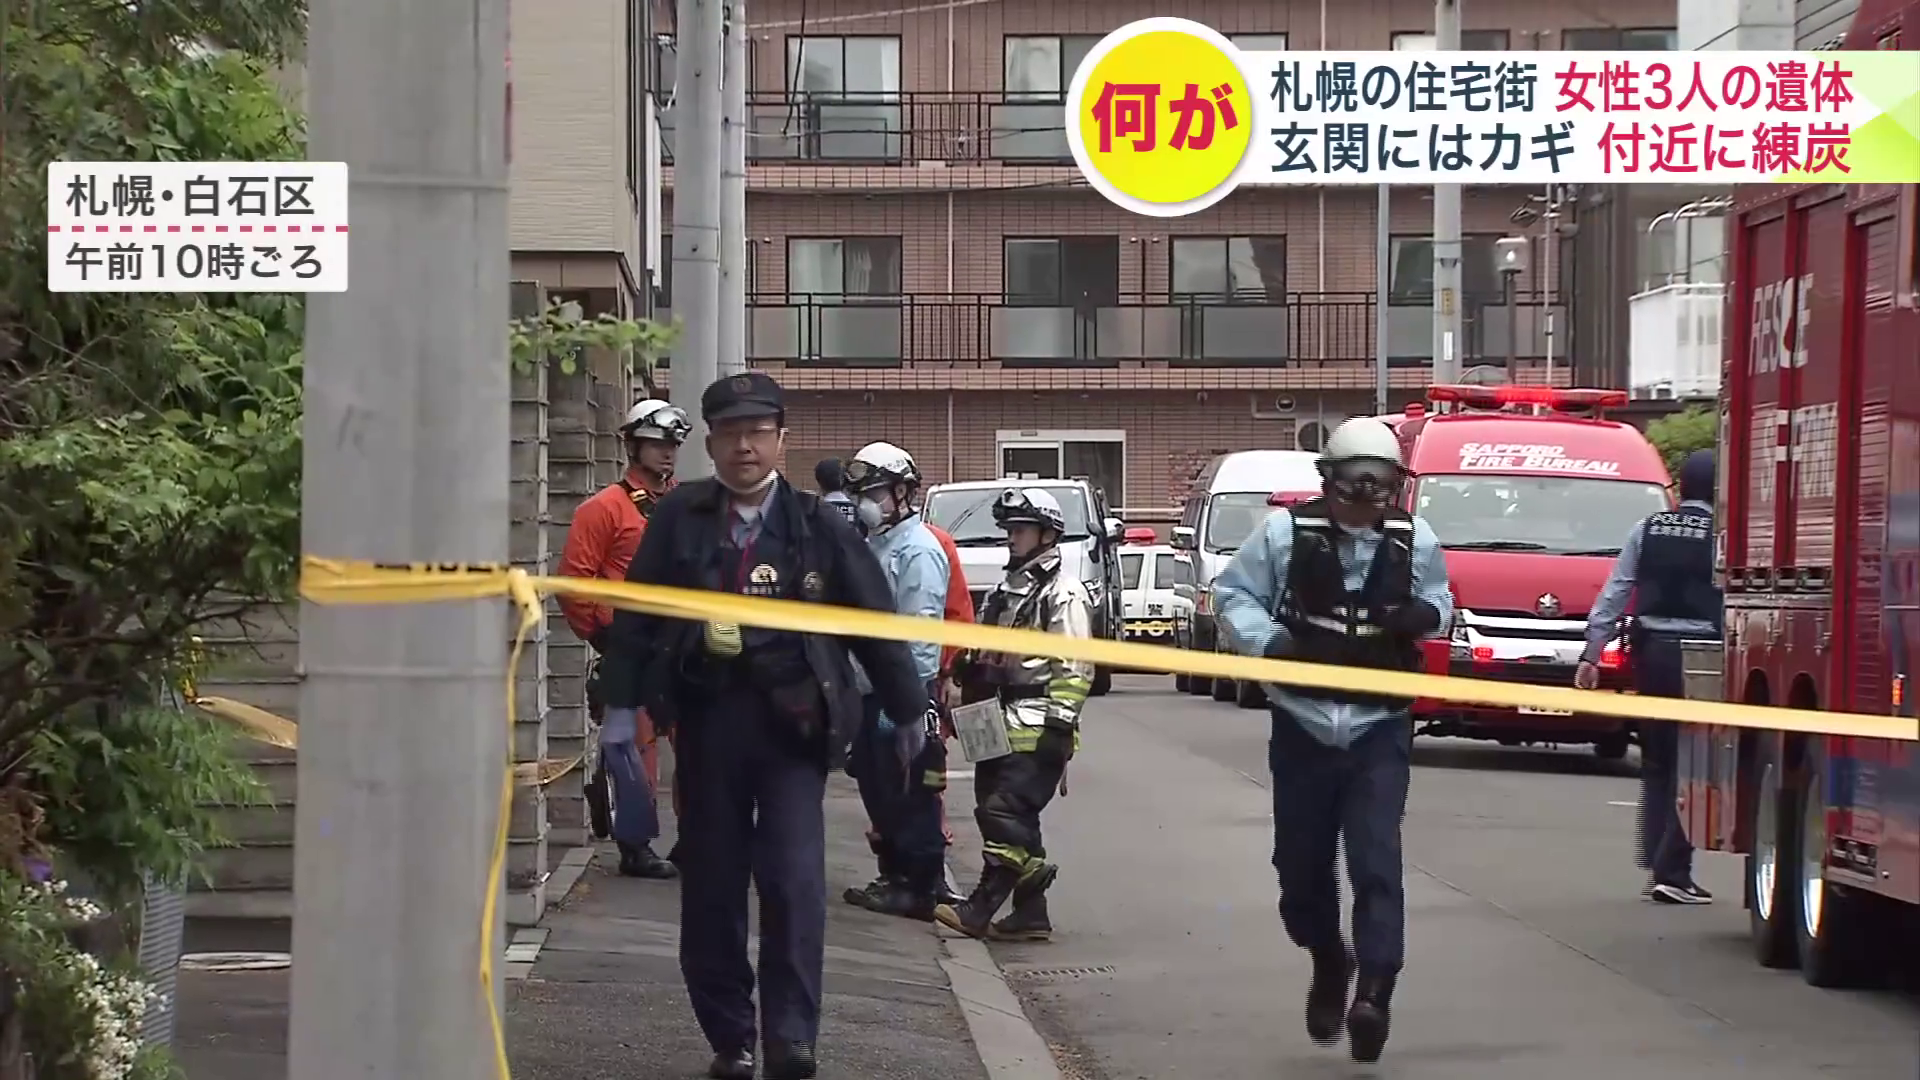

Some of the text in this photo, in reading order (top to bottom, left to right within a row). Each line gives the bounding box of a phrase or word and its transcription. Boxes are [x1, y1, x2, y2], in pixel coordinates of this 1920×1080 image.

[1460, 442, 1564, 456] SAPPORO
[1460, 455, 1620, 472] FIRE BUREAU
[1649, 512, 1712, 528] POLICE
